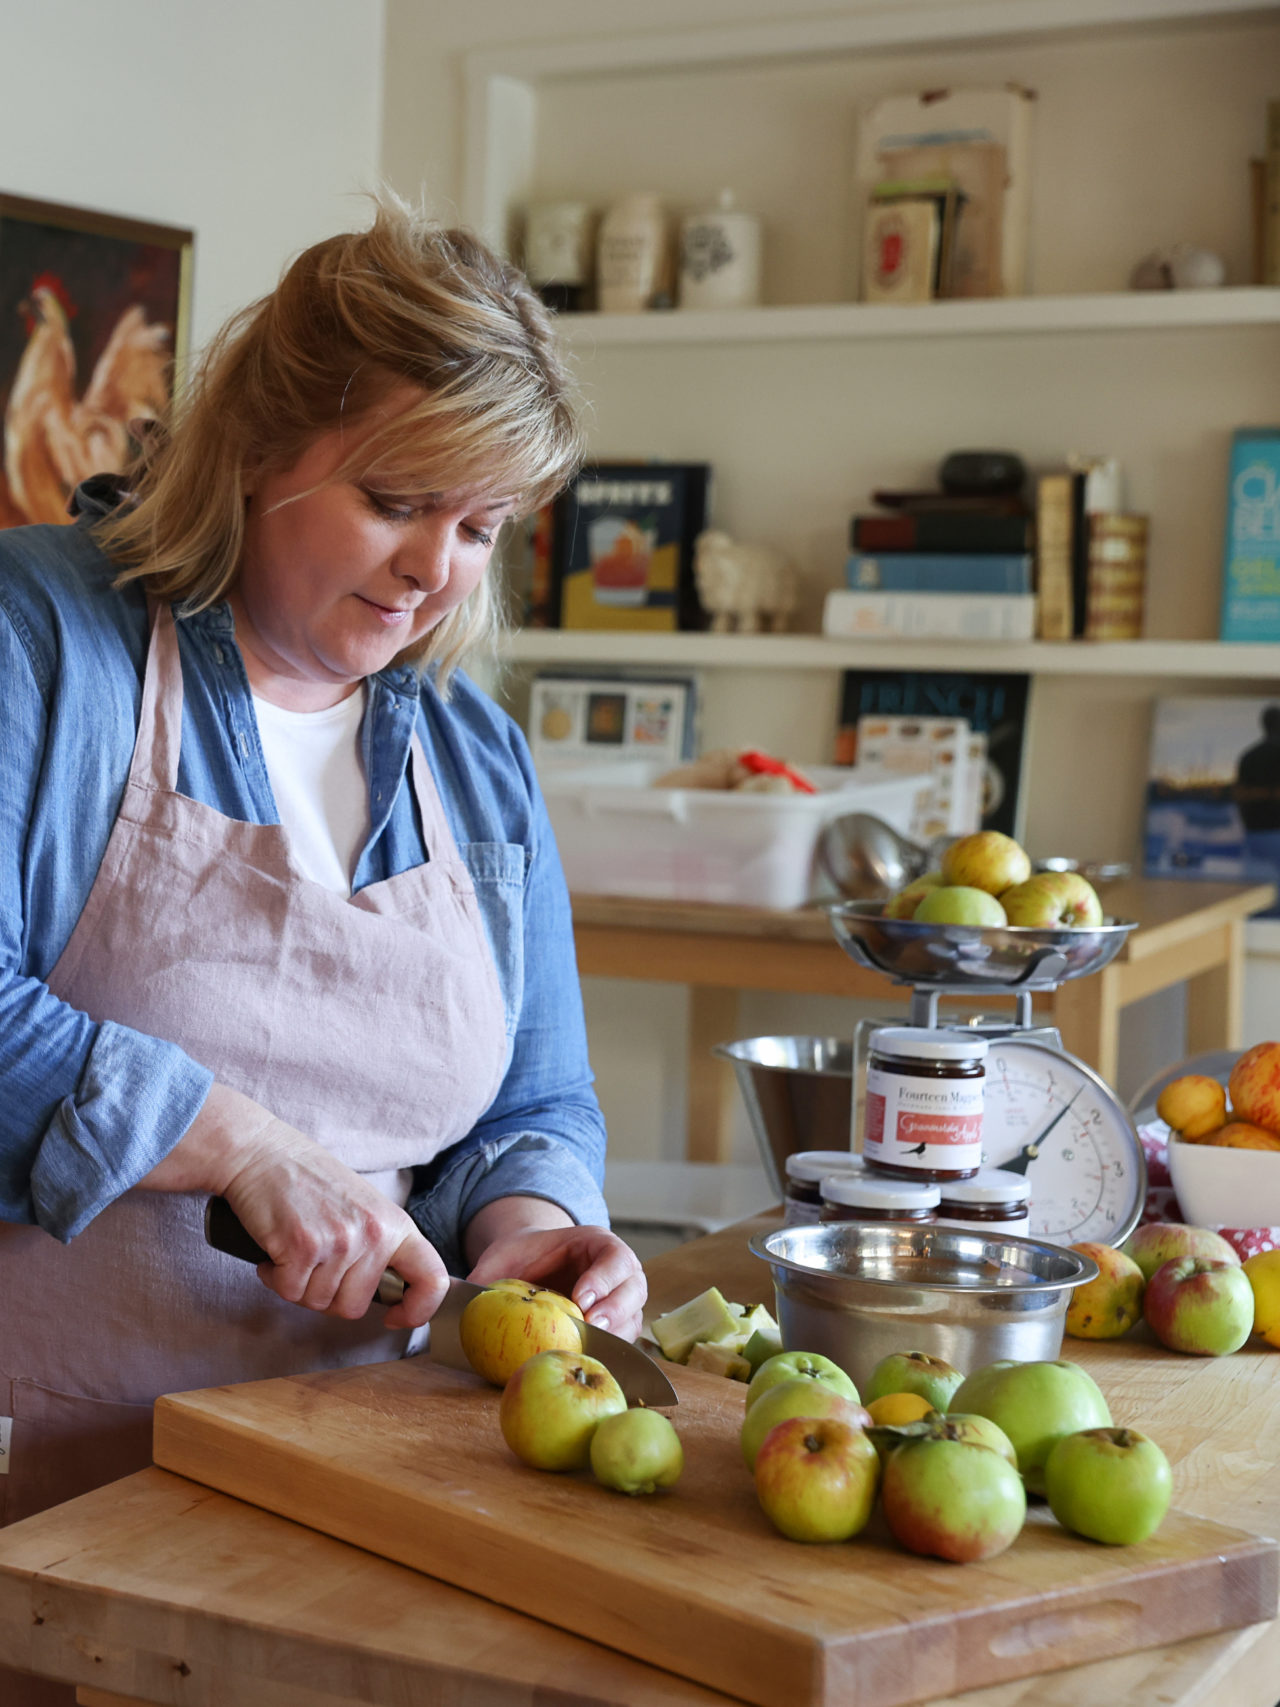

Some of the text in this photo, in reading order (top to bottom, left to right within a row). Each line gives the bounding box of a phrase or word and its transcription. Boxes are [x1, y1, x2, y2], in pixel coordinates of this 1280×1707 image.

[860, 682, 1005, 721] FRENCH
[996, 1057, 1007, 1073] 0
[898, 1086, 948, 1102] Fourteen
[1091, 1108, 1102, 1125] 2
[1113, 1161, 1124, 1177] 3
[1106, 1208, 1116, 1224] 4
